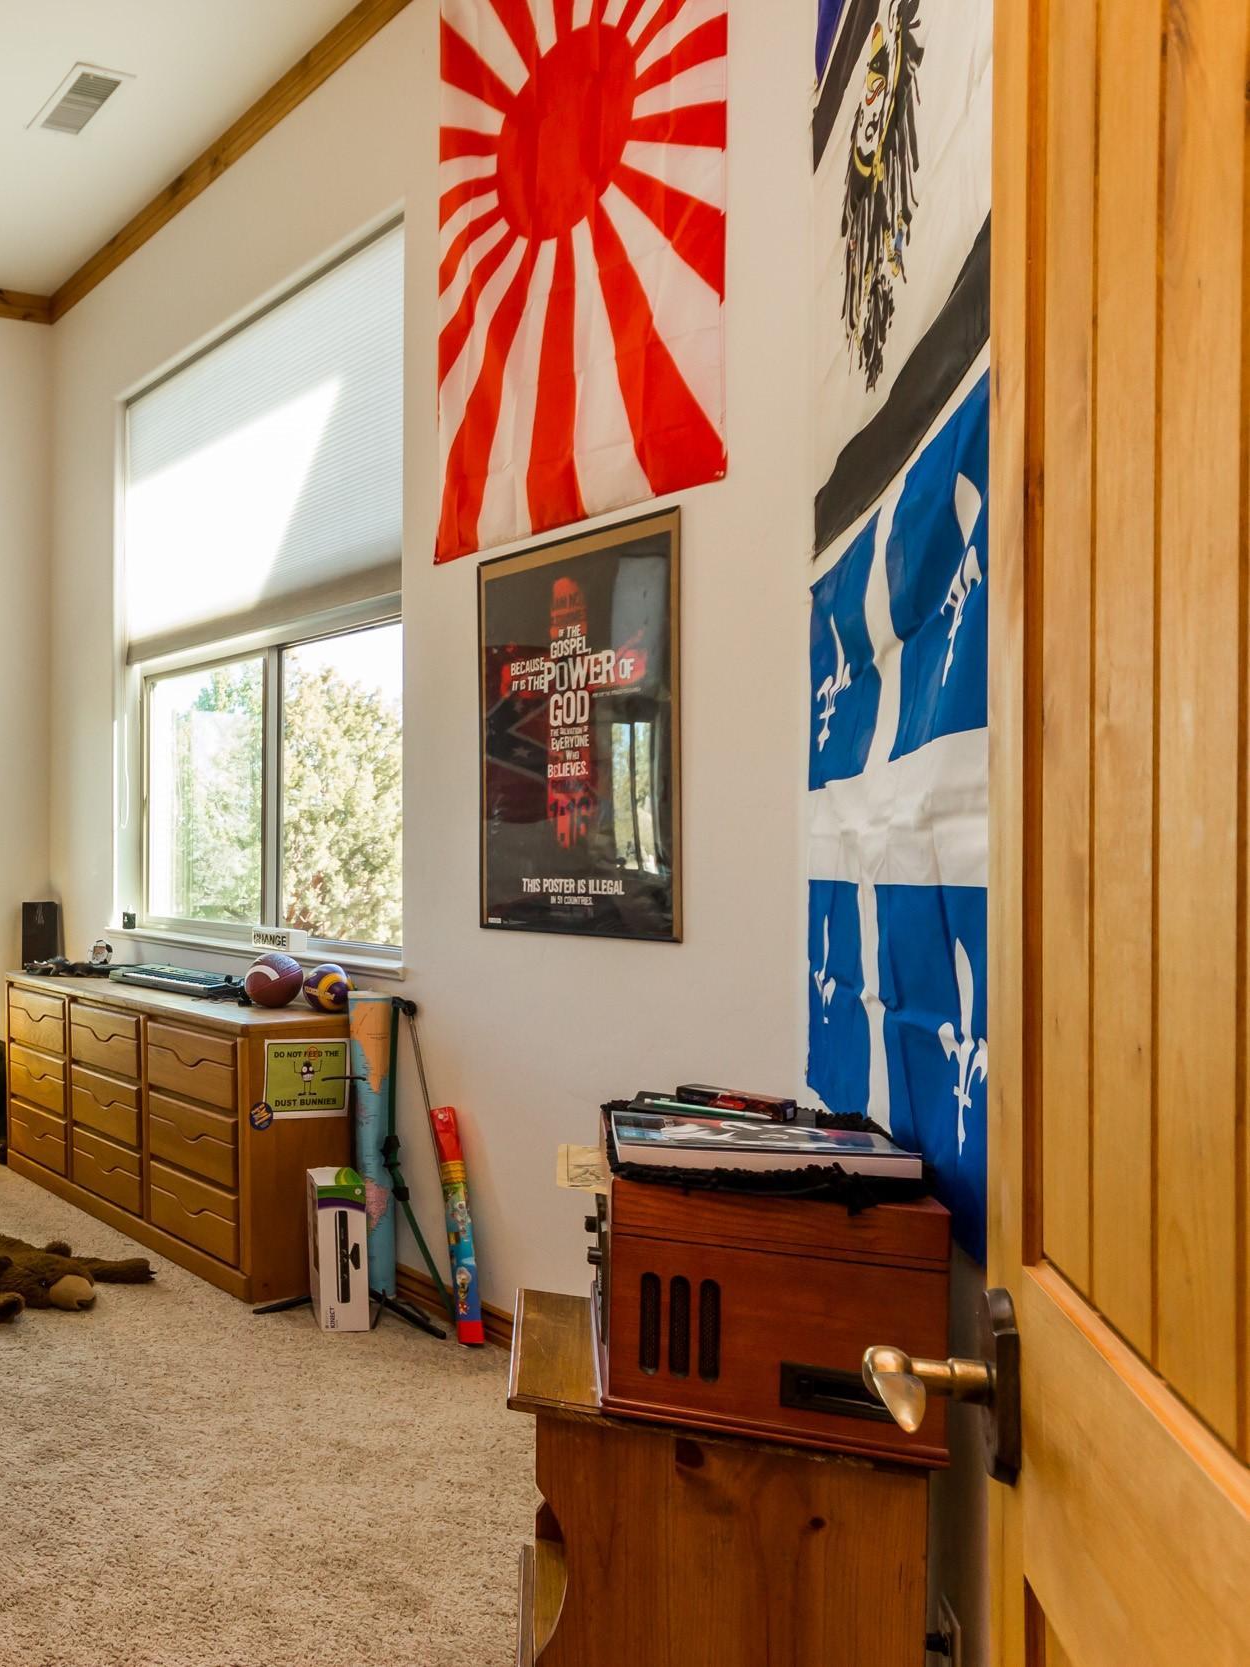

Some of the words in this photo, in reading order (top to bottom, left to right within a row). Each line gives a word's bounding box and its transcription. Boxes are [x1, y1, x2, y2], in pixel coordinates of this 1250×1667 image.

[566, 624, 582, 638] THE
[550, 636, 592, 659] GOSPEL,
[510, 657, 545, 676] BECAUSE
[512, 680, 519, 691] IT
[528, 675, 545, 691] THE
[543, 649, 616, 694] POWER
[618, 658, 635, 679] OF
[550, 690, 590, 727] GOD
[551, 734, 590, 752] EVERYONE
[547, 760, 589, 778] BELIEVES.
[522, 878, 541, 893] THIS
[543, 878, 576, 894] POSTER
[577, 879, 587, 895] IS
[588, 879, 625, 895] ILLEGAL
[550, 895, 557, 904] IN
[253, 930, 287, 947] CHANGE
[274, 1051, 285, 1059] DO
[287, 1050, 302, 1058] NOT
[303, 1050, 323, 1058] FEED
[275, 1099, 298, 1107] DUST
[299, 1097, 337, 1106] BUNNIES
